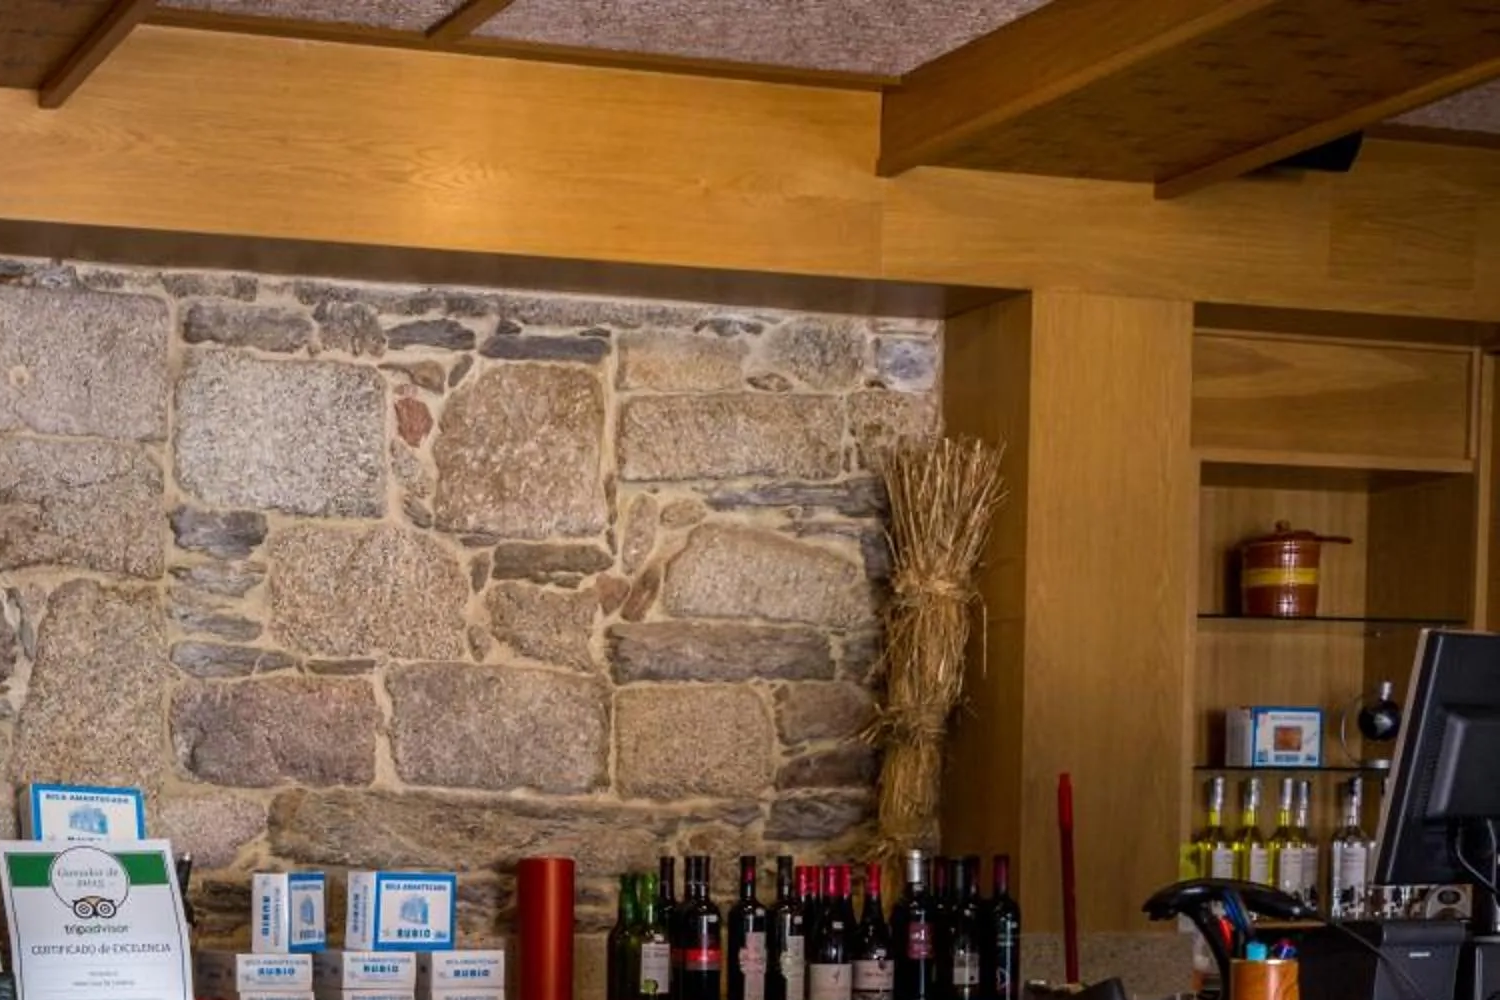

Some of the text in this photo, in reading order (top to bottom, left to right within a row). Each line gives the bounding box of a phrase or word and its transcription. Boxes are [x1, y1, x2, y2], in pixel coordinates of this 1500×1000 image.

[64, 924, 129, 935] tripadvisor
[397, 929, 431, 938] RUBIO
[31, 944, 97, 956] CERTIFICADO
[113, 943, 172, 954] EXCELENCIA
